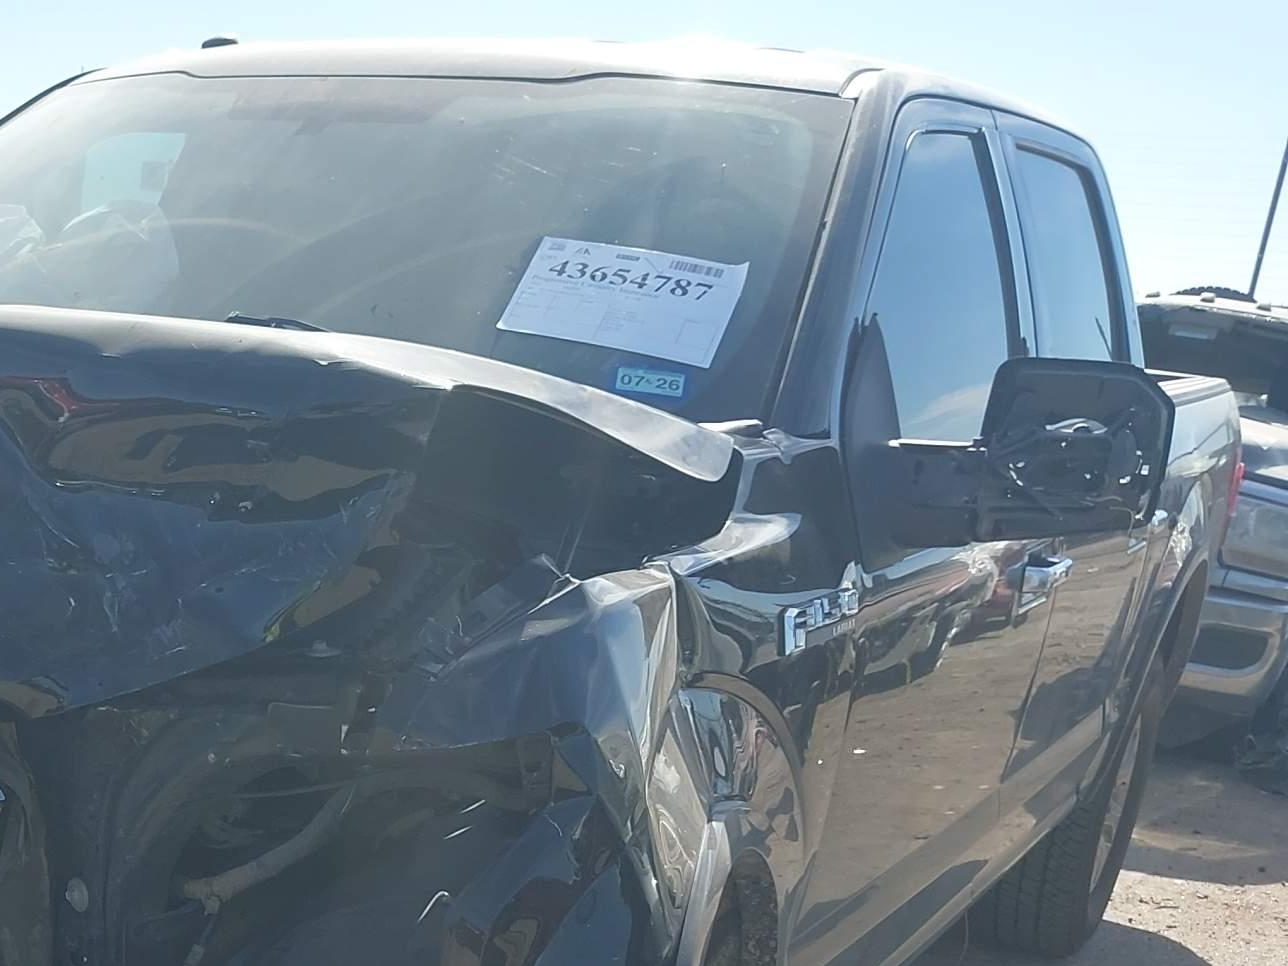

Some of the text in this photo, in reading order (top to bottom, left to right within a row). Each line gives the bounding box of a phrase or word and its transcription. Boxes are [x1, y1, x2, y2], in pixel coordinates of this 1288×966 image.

[548, 260, 714, 301] 43654787
[620, 374, 681, 391] 07 26
